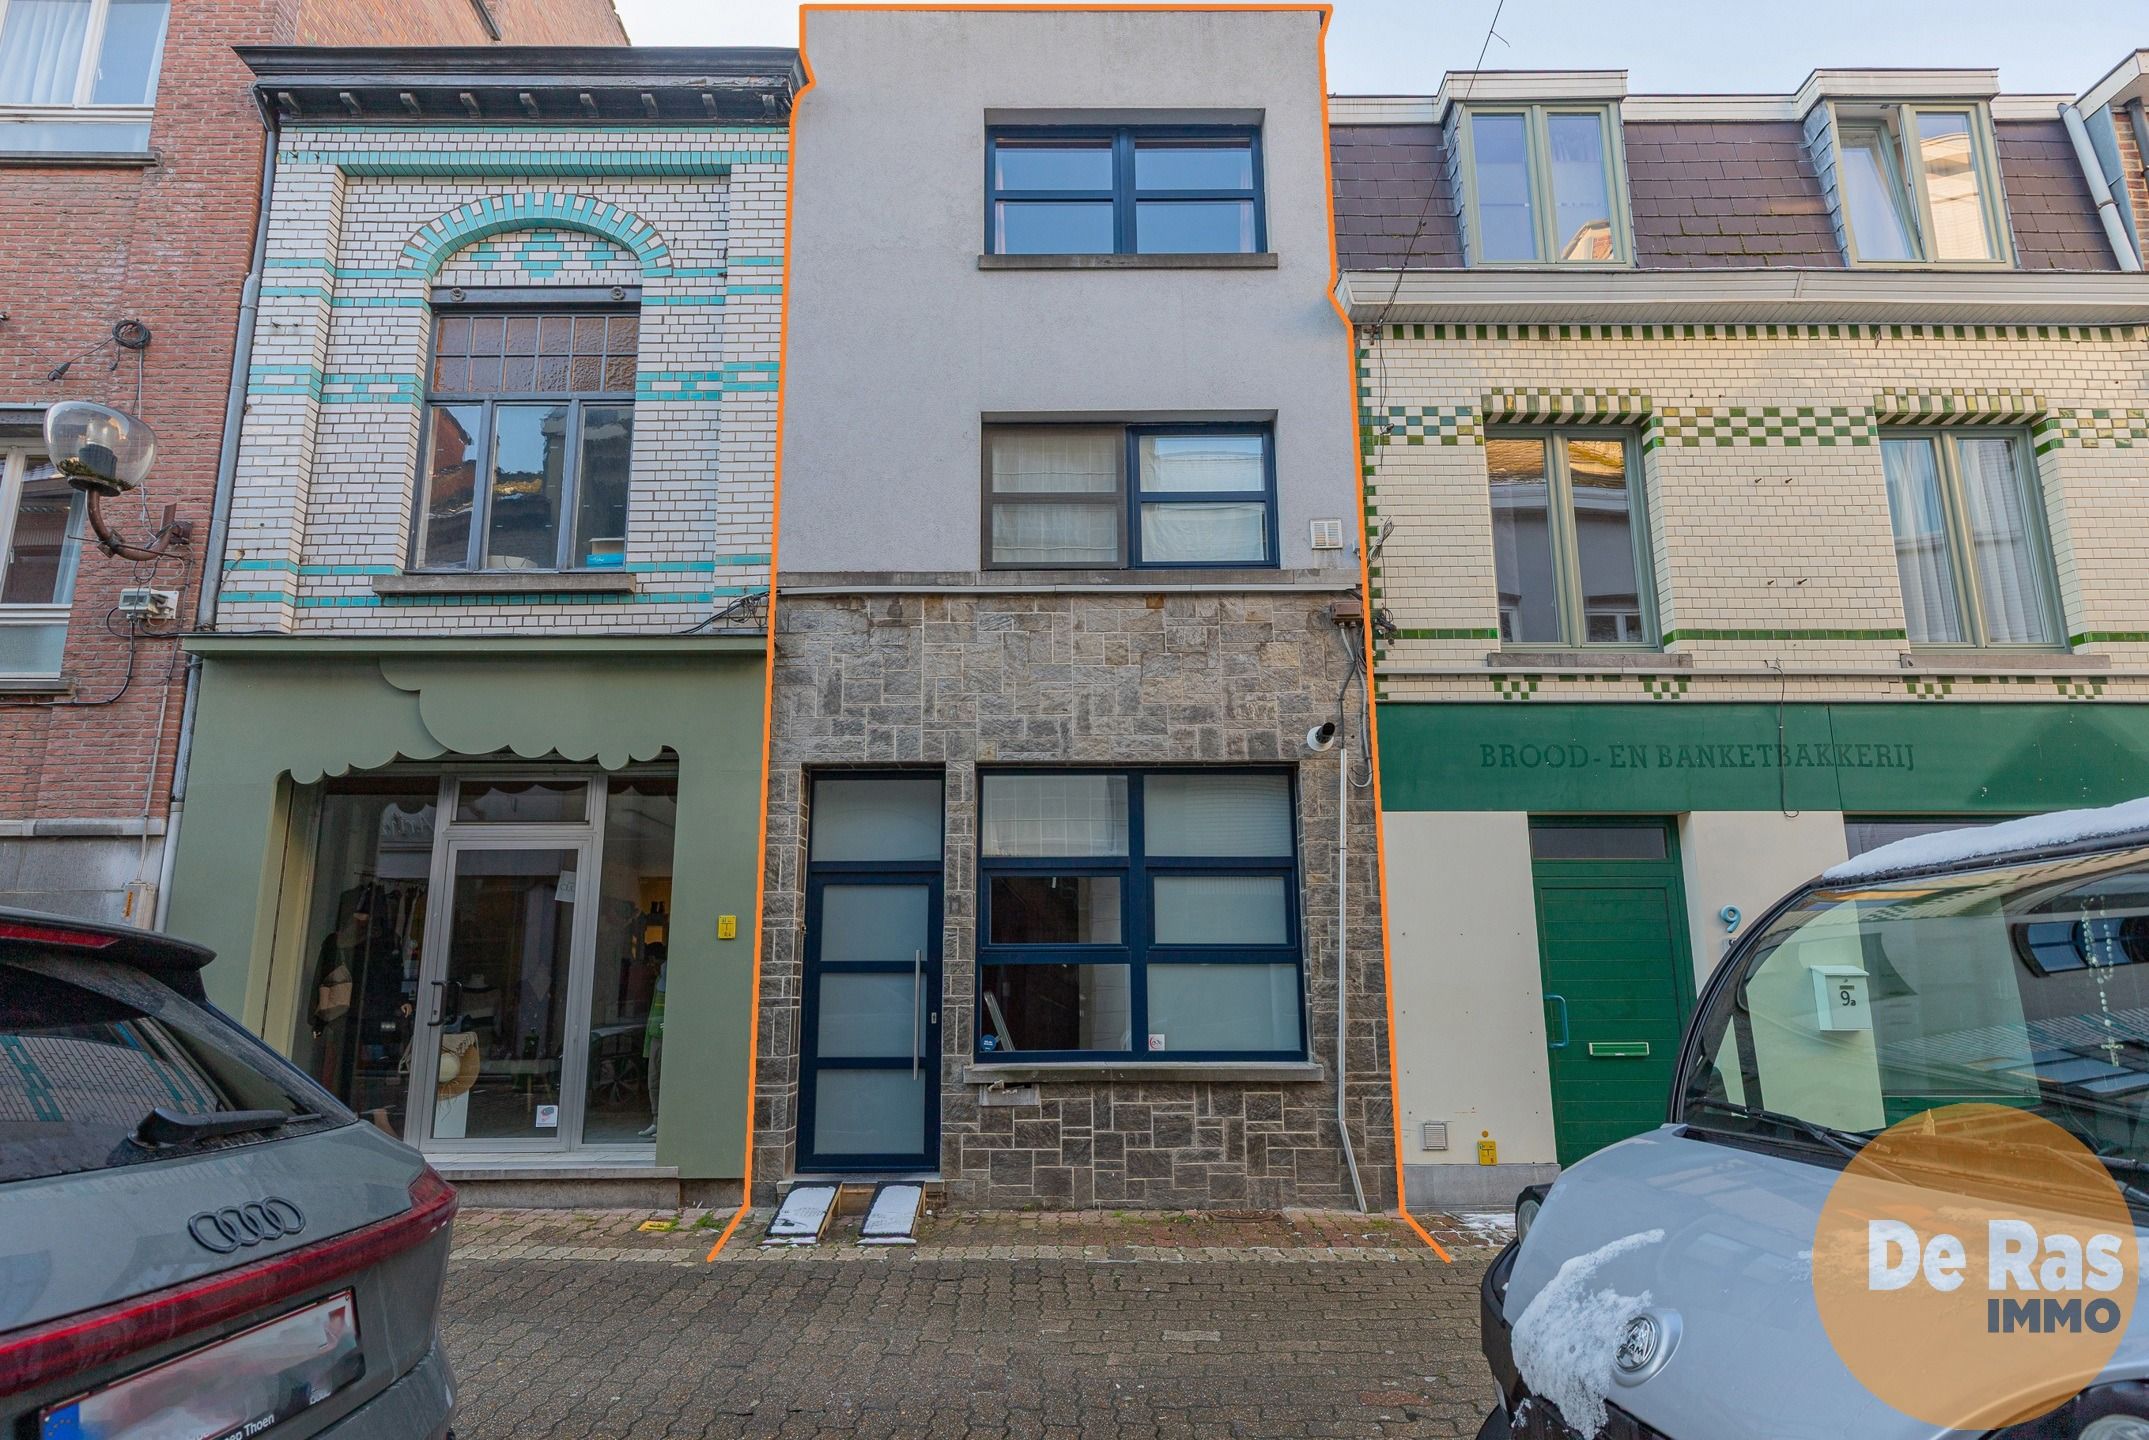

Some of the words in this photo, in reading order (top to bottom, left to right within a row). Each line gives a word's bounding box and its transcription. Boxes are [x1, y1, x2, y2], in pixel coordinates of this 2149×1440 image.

[1480, 743, 1600, 768] BROOD-
[1609, 744, 1648, 768] EN
[1656, 743, 1914, 771] BANKETBAKKERIJ
[1720, 904, 1742, 933] 9
[1840, 990, 1857, 1006] 9a
[243, 1413, 275, 1436] Thoen
